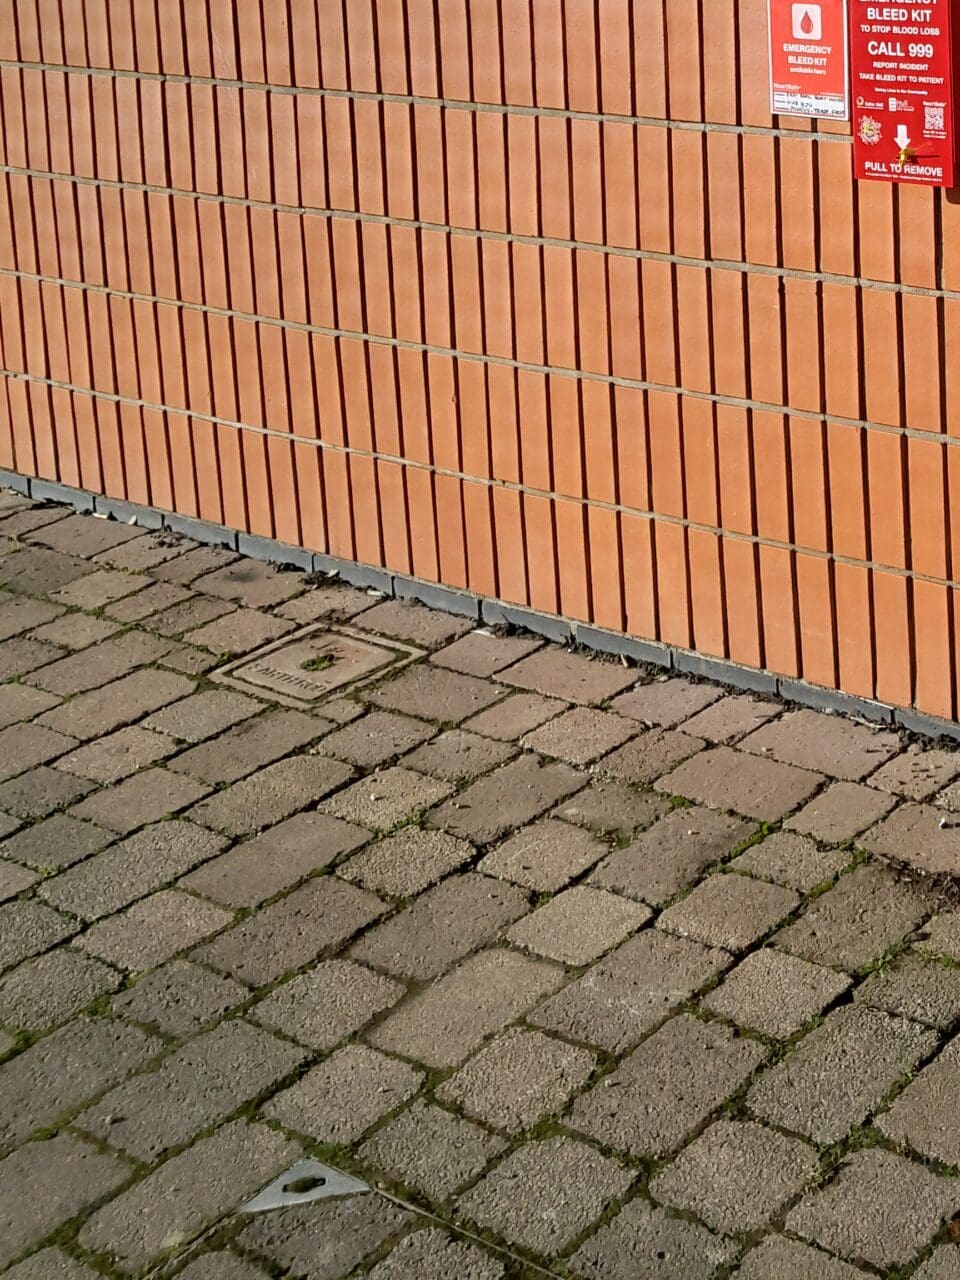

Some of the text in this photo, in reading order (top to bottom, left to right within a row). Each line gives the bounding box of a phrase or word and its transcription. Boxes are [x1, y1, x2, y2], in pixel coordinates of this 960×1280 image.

[867, 7, 932, 22] BLEED KIT
[860, 24, 940, 36] TO STOP BLOOD LOSS
[783, 43, 832, 55] EMERGENCY
[867, 40, 934, 58] CALL 999
[787, 55, 828, 66] BLEED KIT
[873, 61, 929, 71] REPORT INCIDENT
[876, 73, 896, 81] BLEED
[918, 76, 944, 84] PATIENT
[864, 161, 888, 172] PULL
[890, 164, 902, 173] TO
[904, 164, 943, 177] REMOVE
